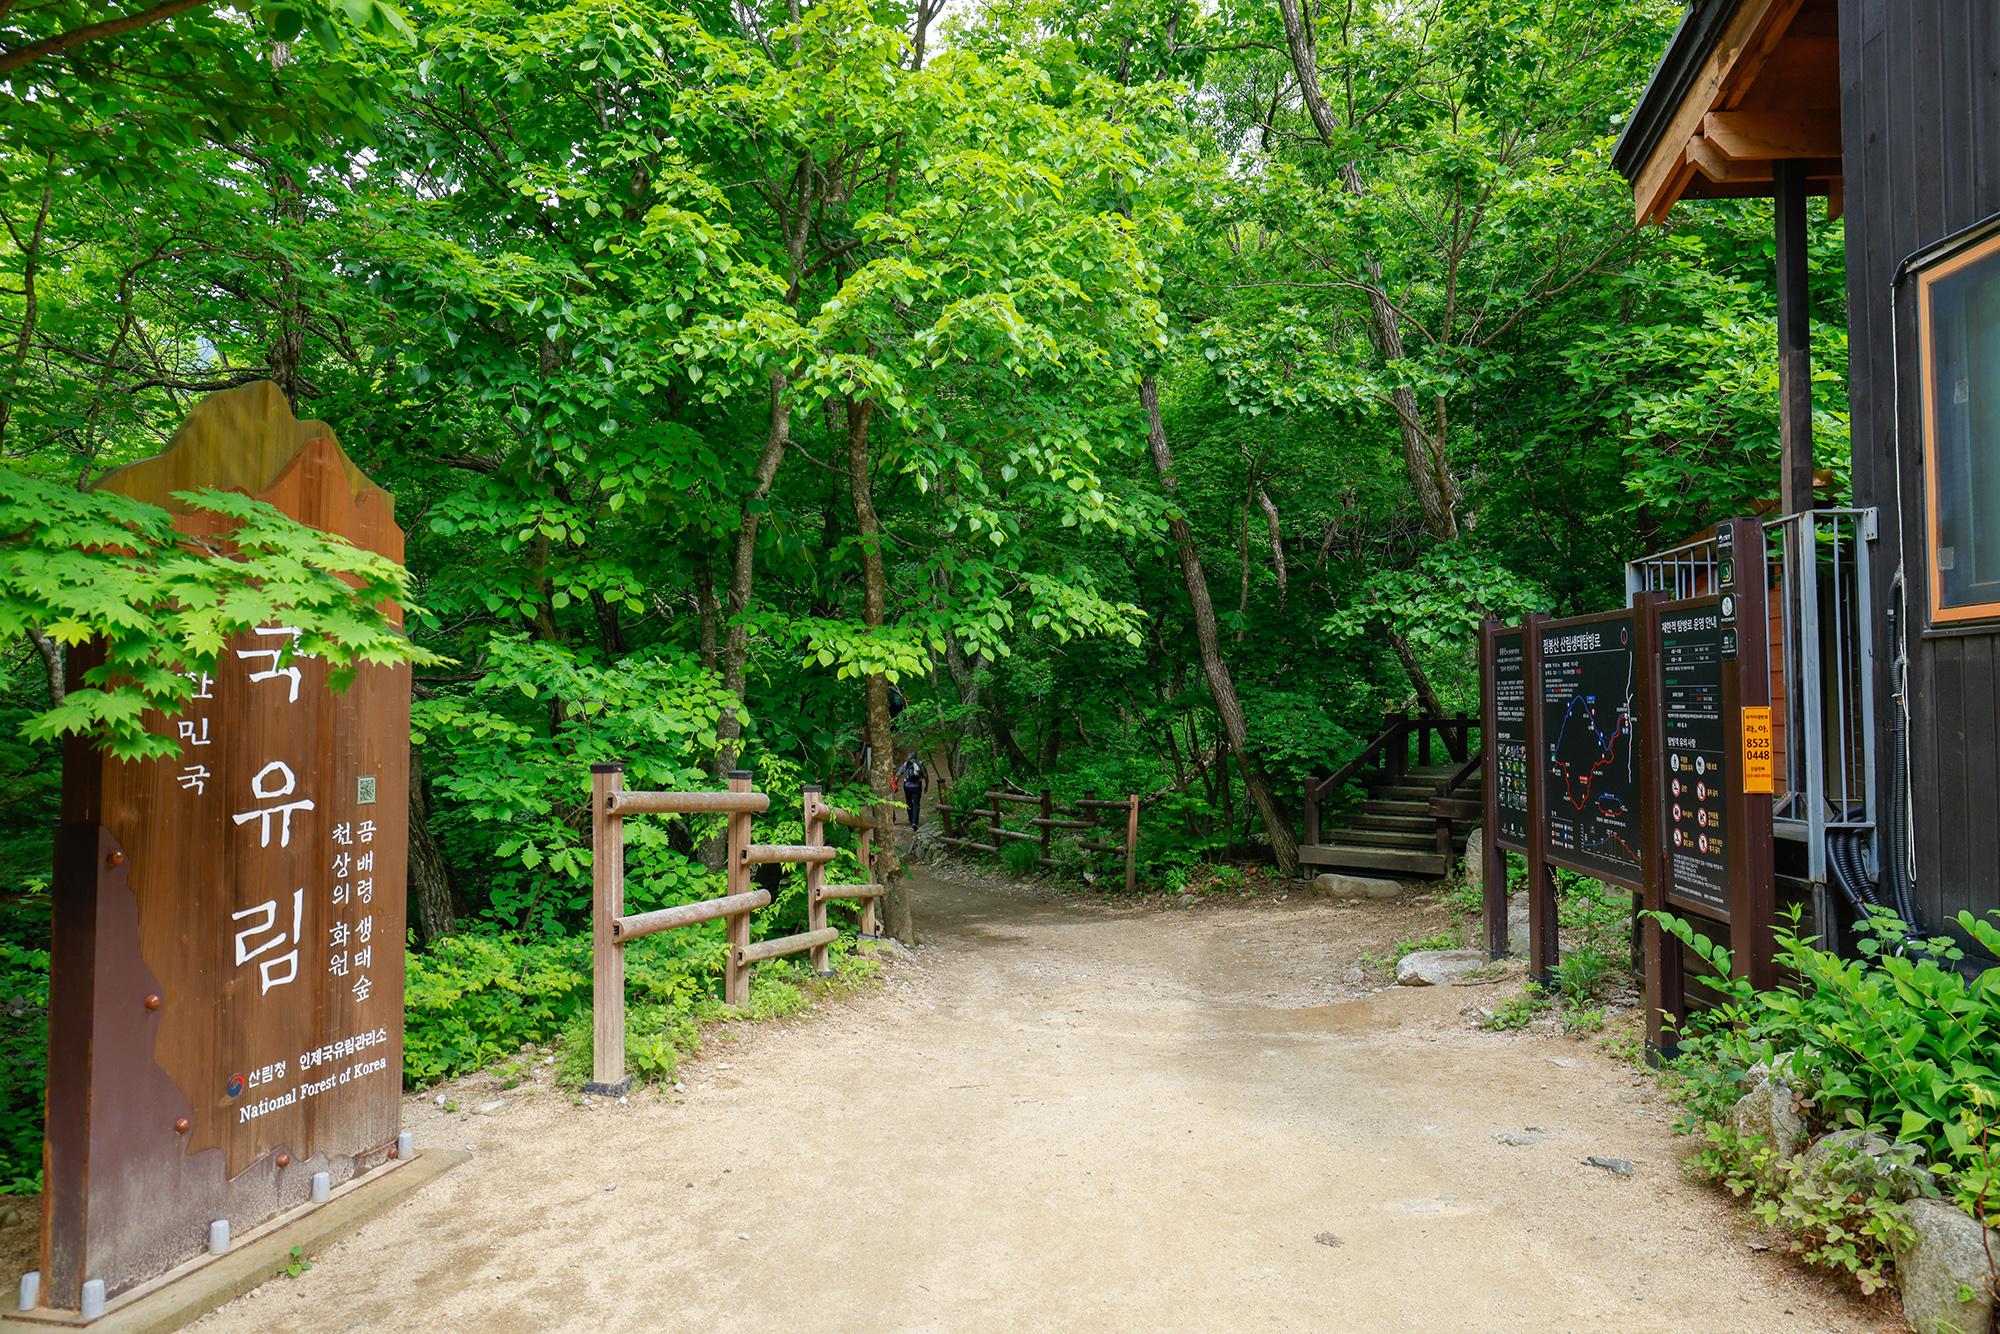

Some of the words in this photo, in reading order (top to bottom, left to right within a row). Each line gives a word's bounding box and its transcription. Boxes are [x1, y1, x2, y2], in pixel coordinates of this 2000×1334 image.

[1543, 637, 1559, 654] 점봉산
[1677, 619, 1693, 633] 탐방로
[1694, 617, 1705, 631] 운영
[1705, 615, 1717, 630] 안내
[1746, 738, 1769, 748] 8523
[1747, 750, 1770, 760] 0448
[332, 822, 353, 905] 천상의
[356, 820, 377, 904] 곰배령
[328, 921, 350, 976] 화원
[352, 915, 373, 1002] 생태숲
[248, 1060, 286, 1088] 산림청
[299, 1028, 387, 1071] 인제국유림관리소
[239, 1088, 297, 1123] National
[300, 1073, 337, 1100] Forest
[339, 1067, 351, 1085] of
[353, 1057, 387, 1080] Korea
